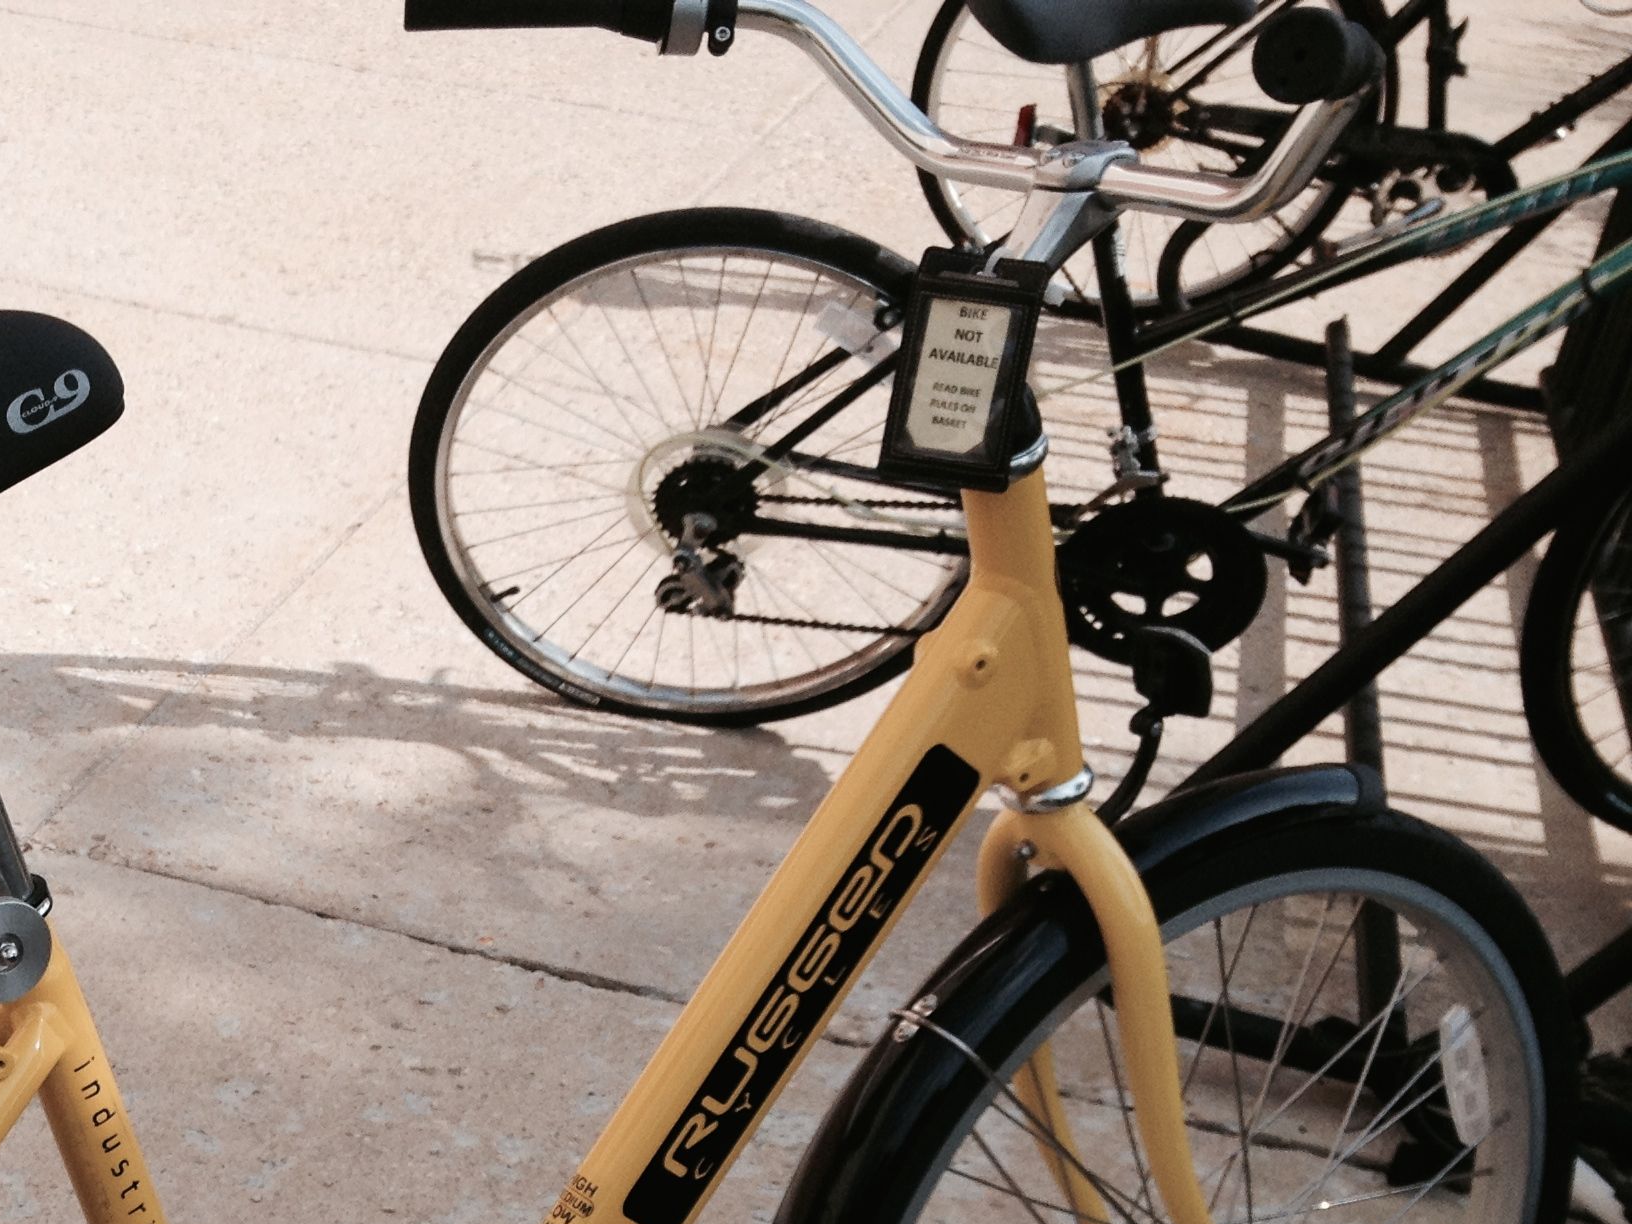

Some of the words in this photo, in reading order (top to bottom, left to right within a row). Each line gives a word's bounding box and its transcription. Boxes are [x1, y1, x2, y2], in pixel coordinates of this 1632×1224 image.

[959, 305, 988, 320] BIKE
[954, 328, 984, 343] NOT
[928, 347, 999, 369] AVAILABLE
[6, 369, 91, 434] C9
